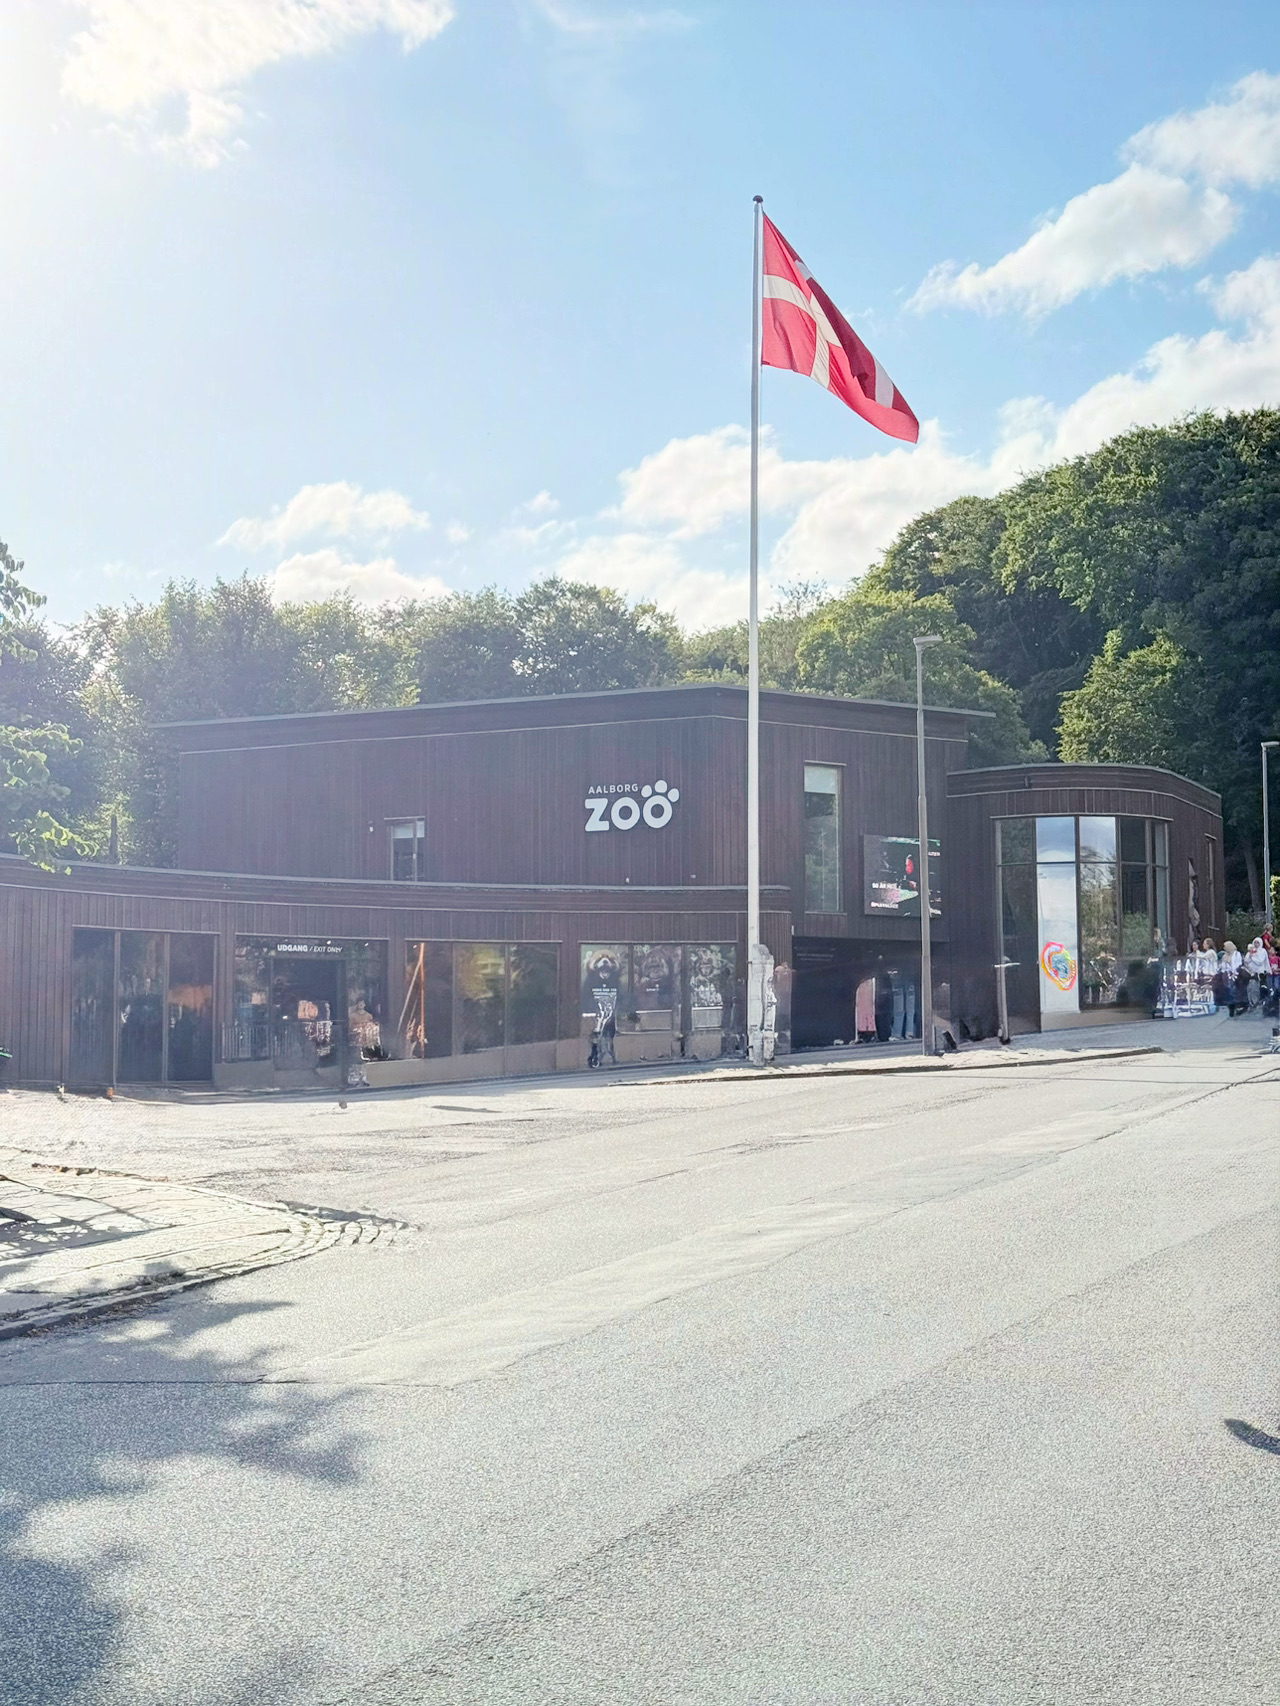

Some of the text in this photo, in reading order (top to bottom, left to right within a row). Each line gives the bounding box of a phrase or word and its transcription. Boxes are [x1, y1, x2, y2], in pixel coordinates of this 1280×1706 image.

[588, 783, 639, 794] AALBORG
[585, 795, 673, 832] ZOO
[277, 944, 308, 952] UDGANG
